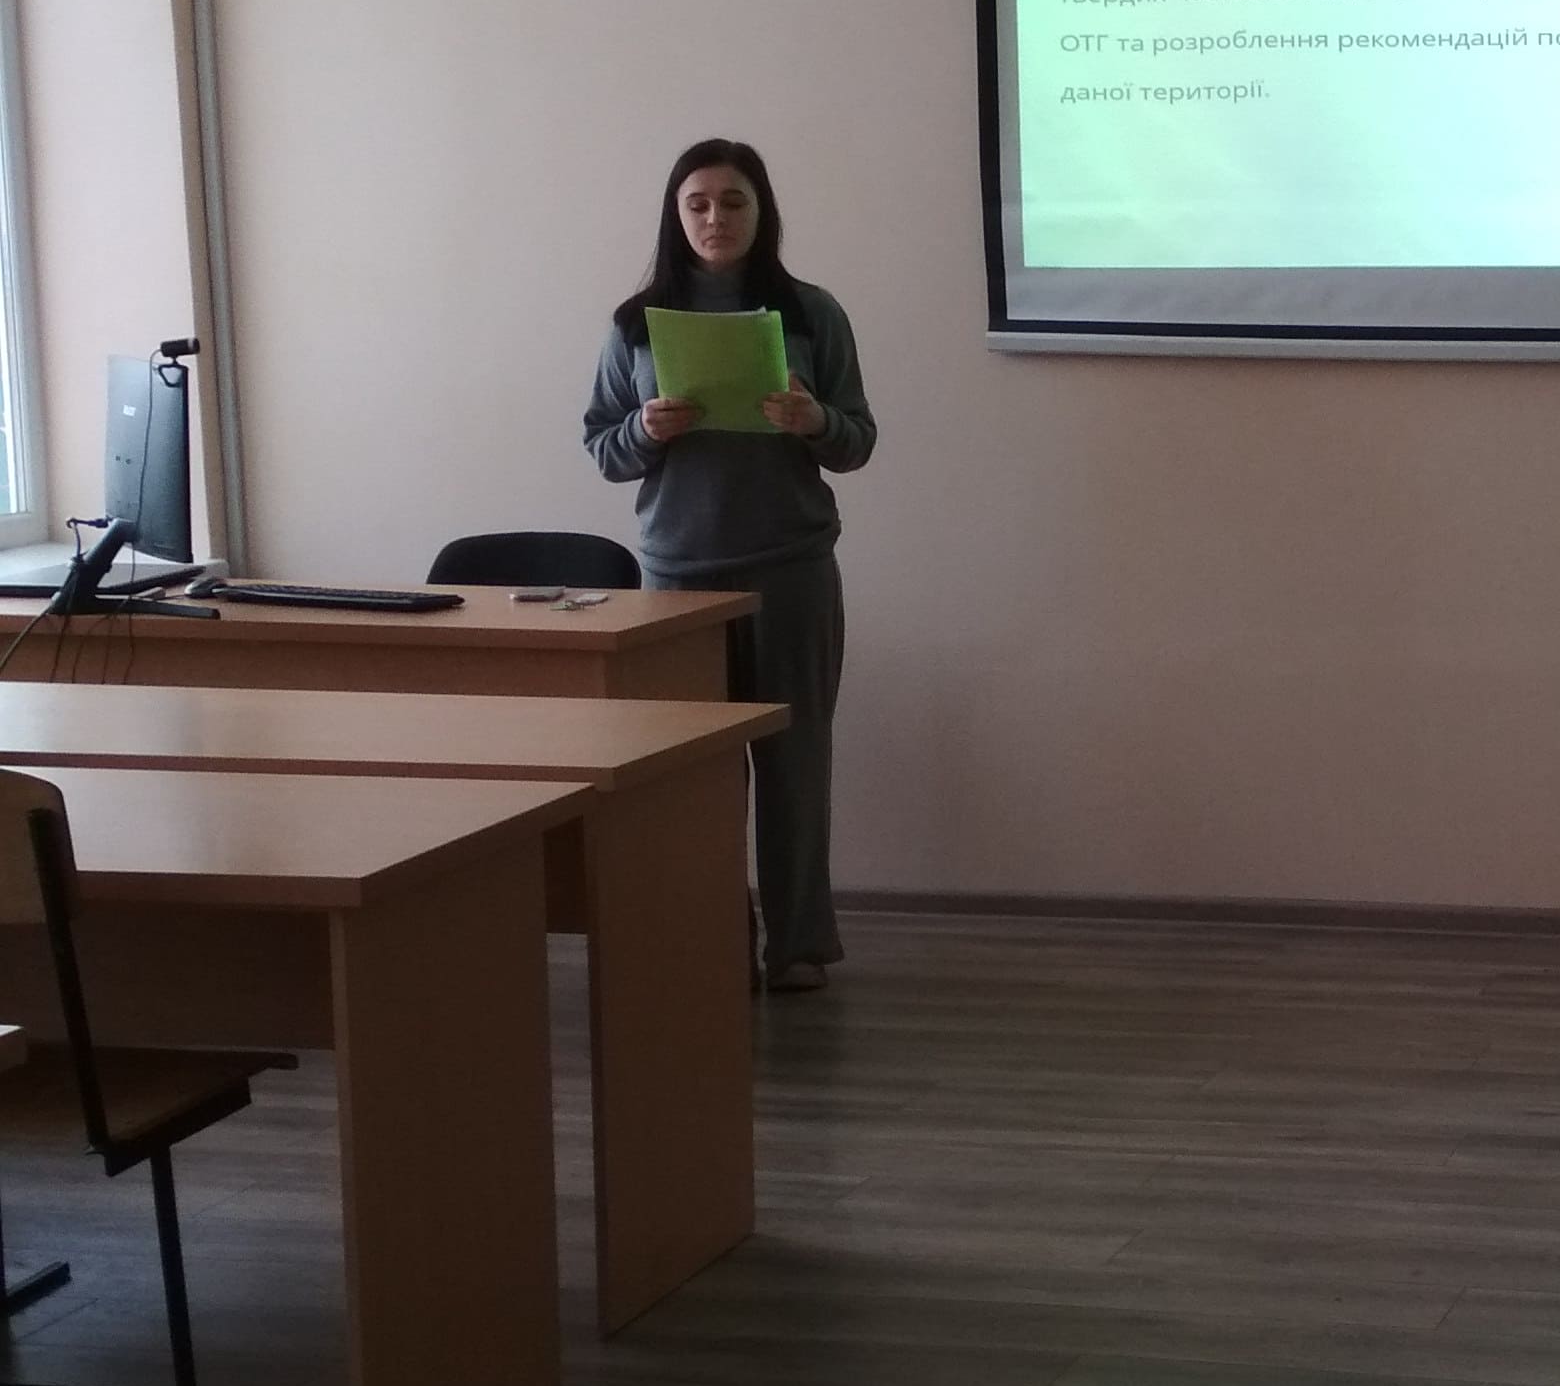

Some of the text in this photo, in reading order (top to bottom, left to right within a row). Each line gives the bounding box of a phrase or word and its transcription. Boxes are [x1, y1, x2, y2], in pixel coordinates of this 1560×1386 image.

[1059, 33, 1109, 53] ОТГ
[1116, 37, 1145, 53] та
[1152, 28, 1329, 57] розроблення
[1337, 27, 1528, 54] рекомендацій
[1059, 80, 1270, 106] даної території.
